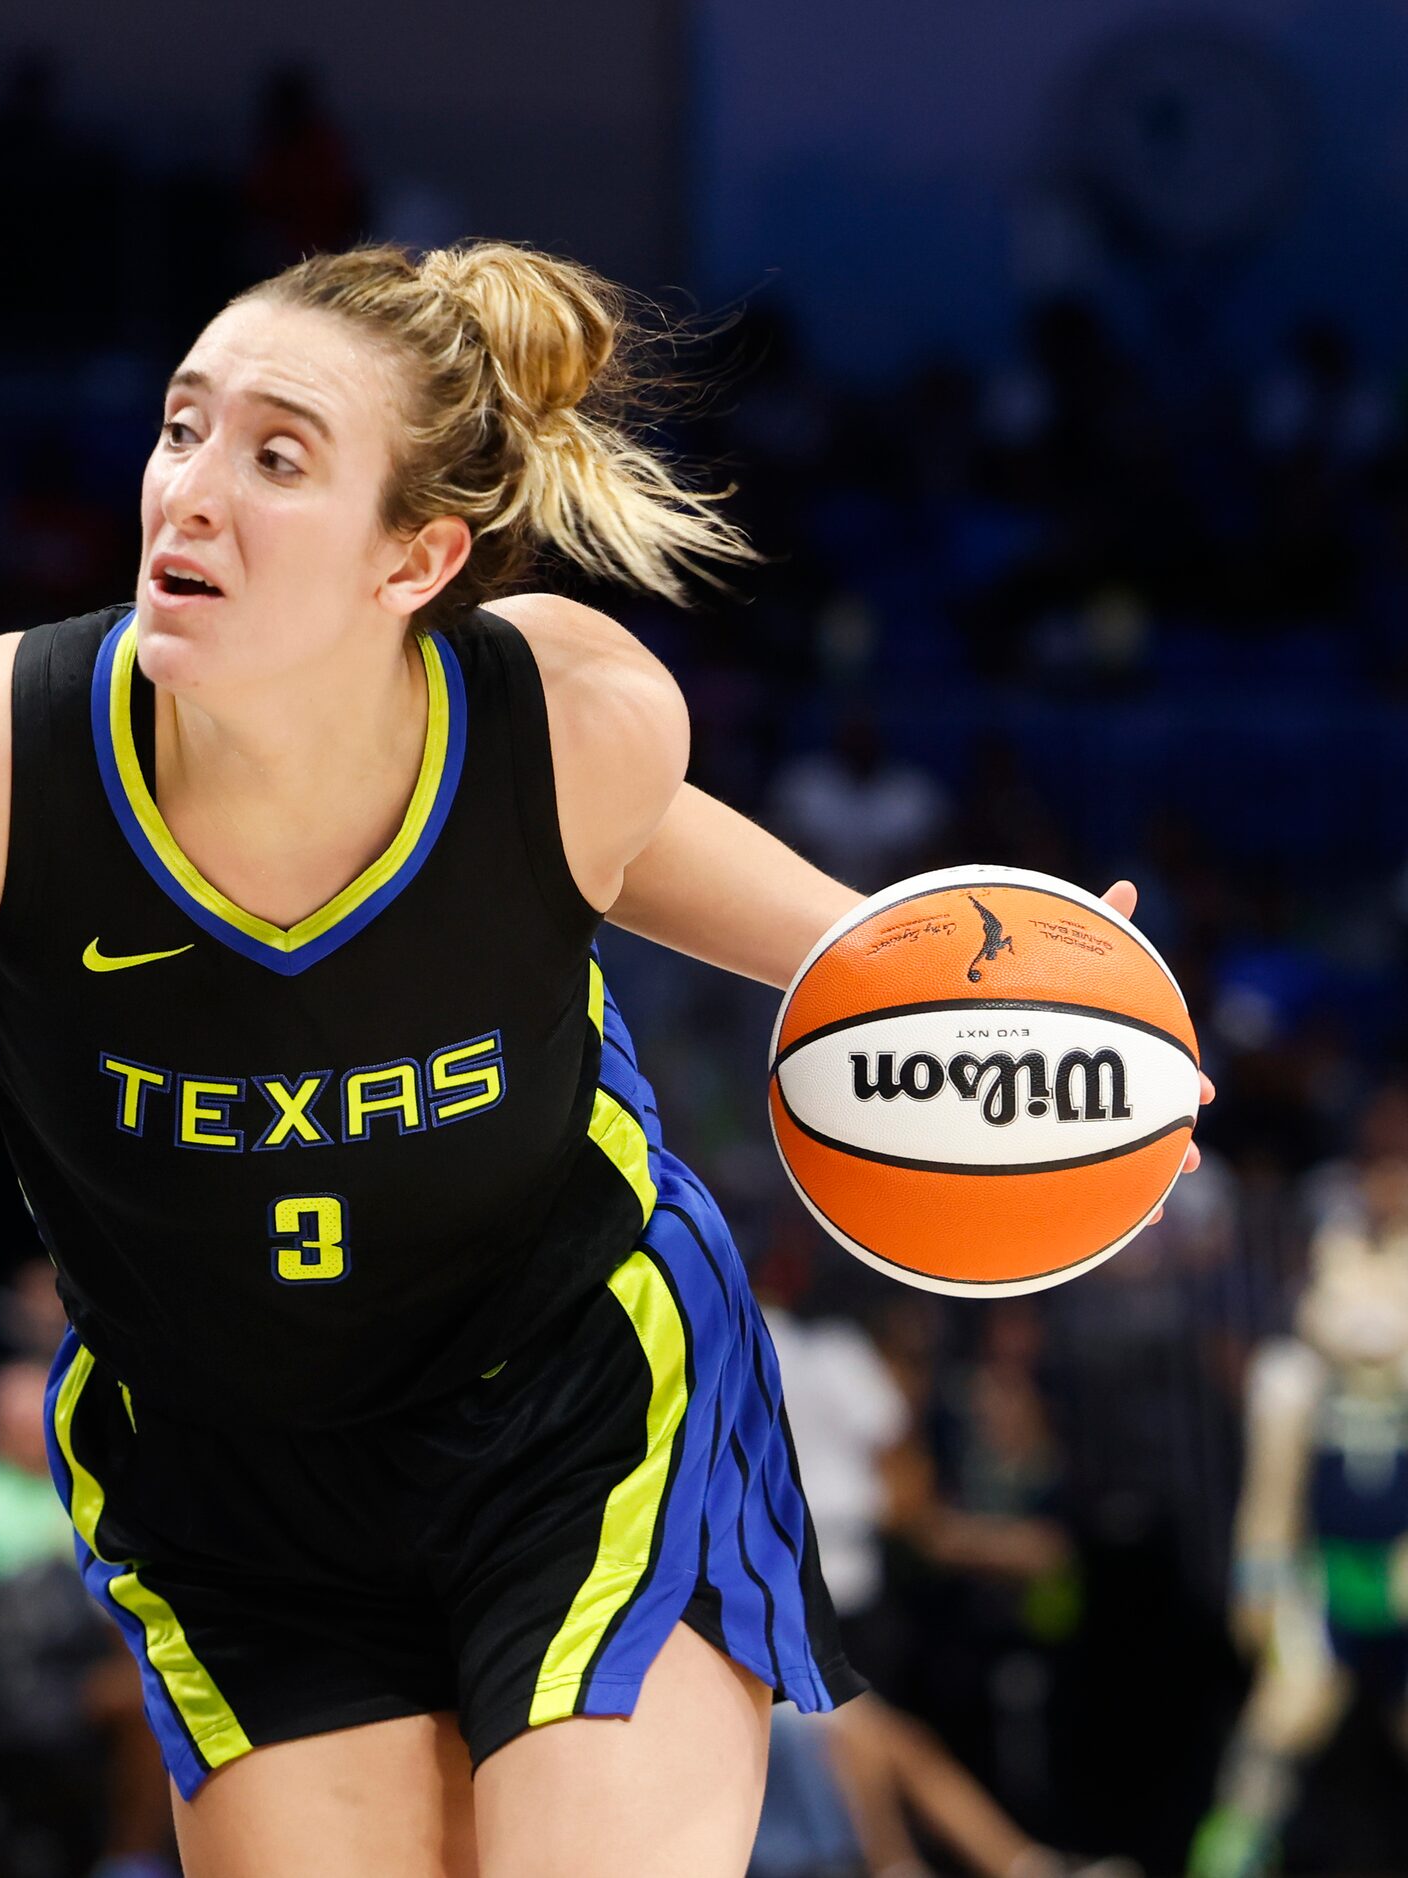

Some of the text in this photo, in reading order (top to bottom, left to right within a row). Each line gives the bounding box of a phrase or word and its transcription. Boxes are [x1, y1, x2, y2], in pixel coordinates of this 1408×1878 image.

[1028, 920, 1068, 935] BALL
[1072, 929, 1113, 950] GAME
[1039, 931, 1105, 956] OFFICIAL
[956, 1028, 1030, 1038] EVO NXT
[99, 1029, 506, 1153] TEXAS
[848, 1045, 1133, 1128] Wilson
[267, 1192, 352, 1286] 3
